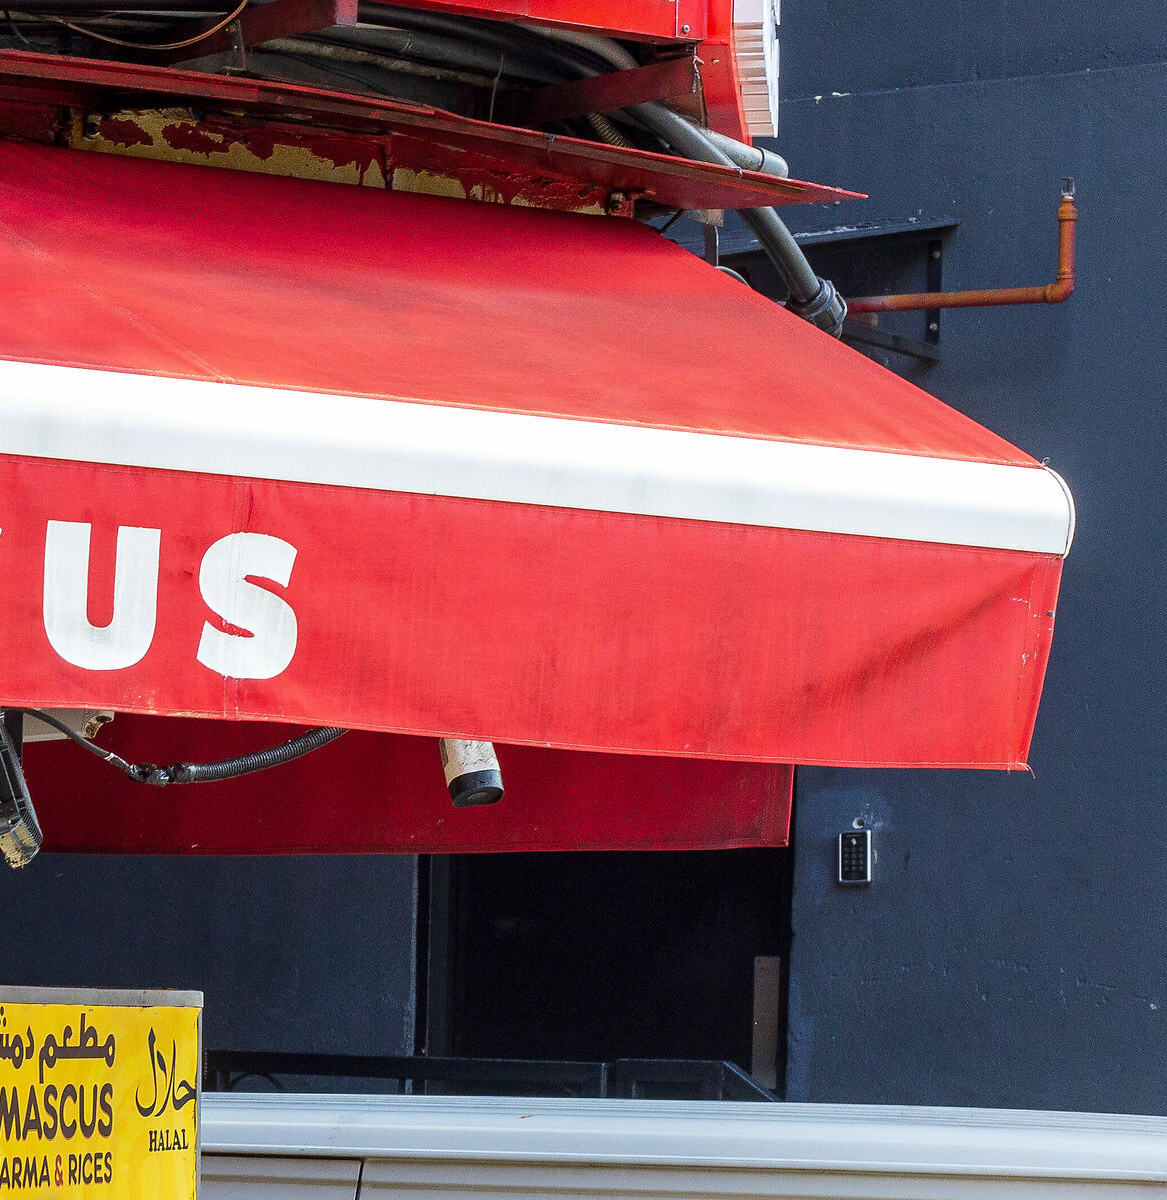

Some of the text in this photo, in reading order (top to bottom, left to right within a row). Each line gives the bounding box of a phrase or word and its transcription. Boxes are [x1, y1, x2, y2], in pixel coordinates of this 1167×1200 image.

[39, 1012, 116, 1084] مطعم
[135, 1026, 197, 1117] حلال
[148, 1128, 189, 1152] HALAL
[54, 1154, 64, 1187] &
[68, 1151, 113, 1186] RICES
